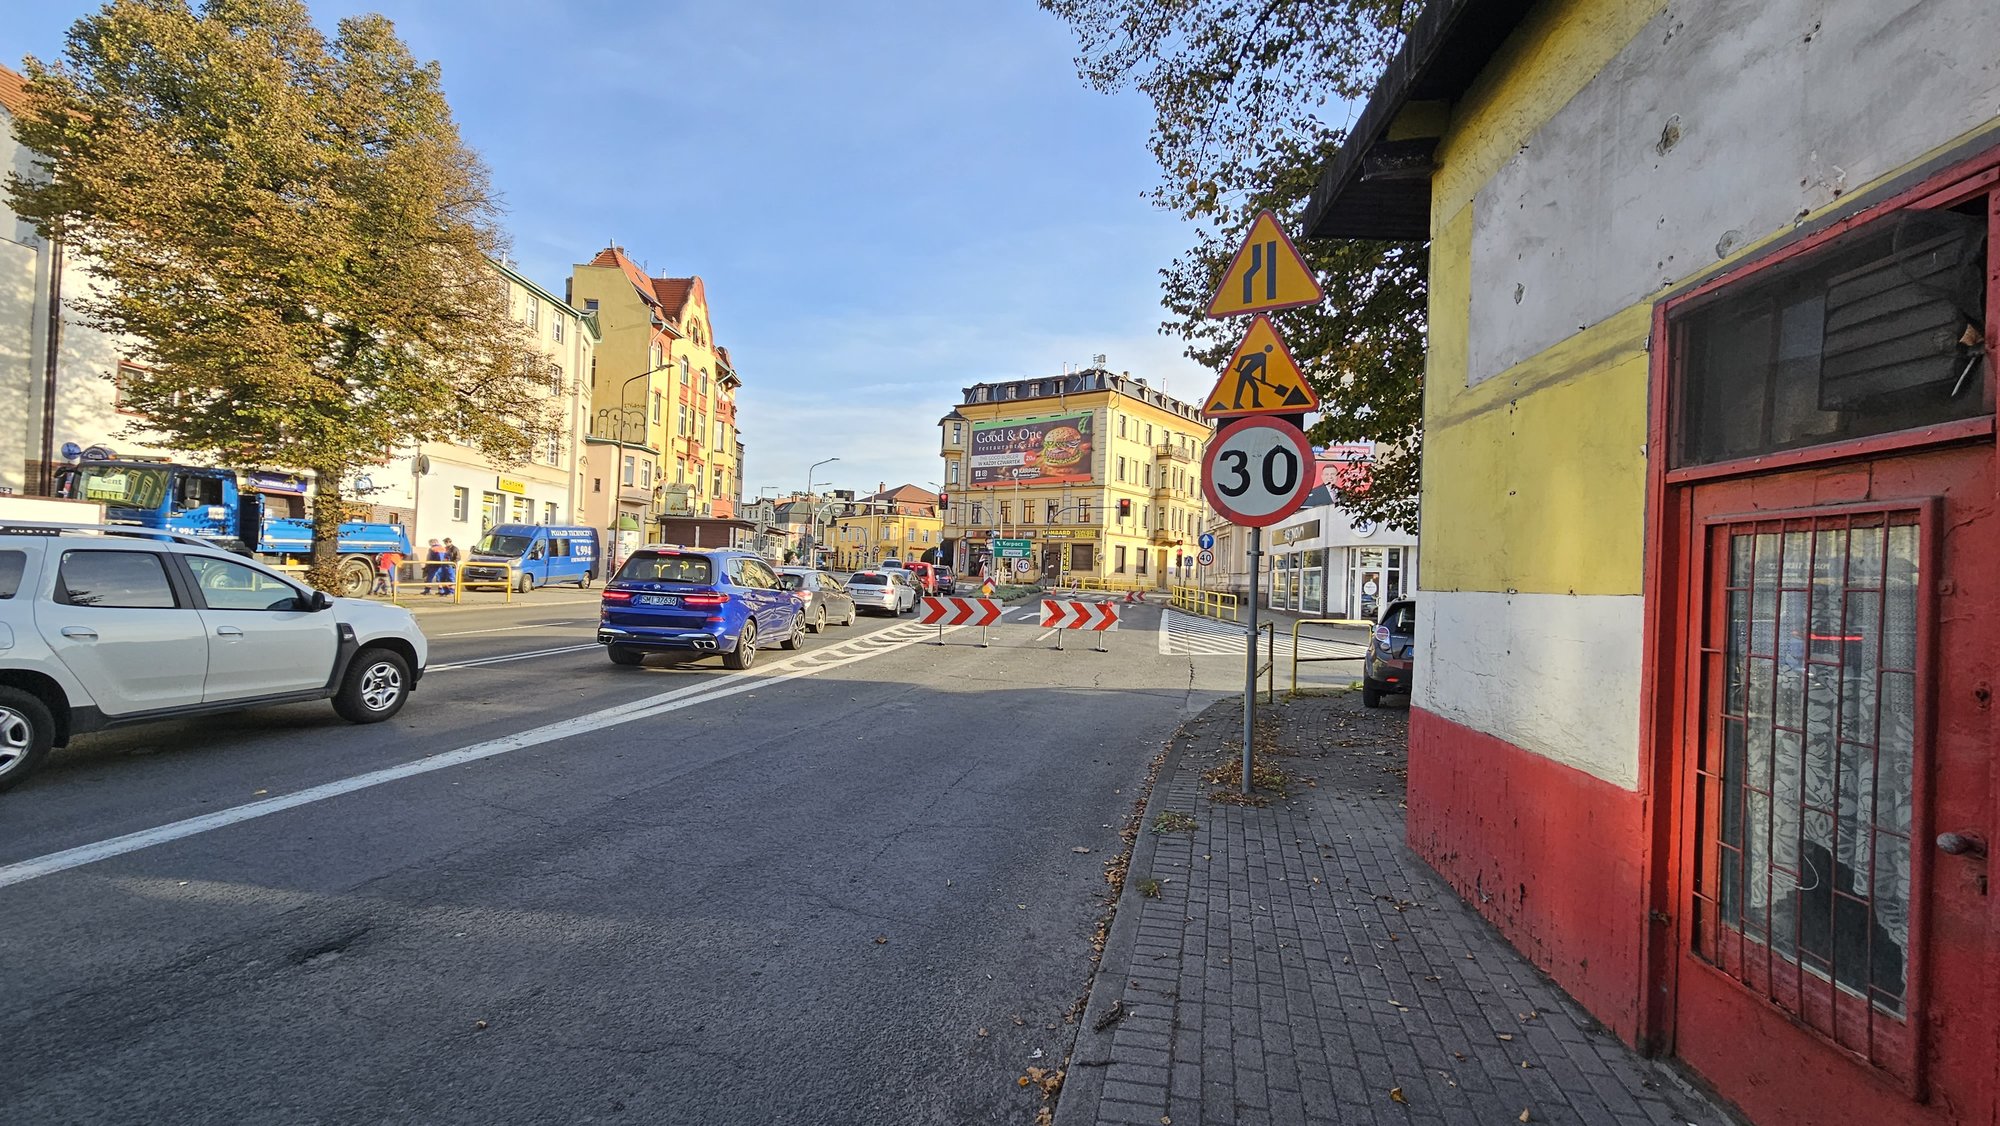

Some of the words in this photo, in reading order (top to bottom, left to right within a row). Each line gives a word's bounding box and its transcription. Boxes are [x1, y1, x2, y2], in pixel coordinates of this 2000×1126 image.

[976, 430, 1004, 443] Good
[1007, 429, 1014, 441] &
[1020, 428, 1043, 441] One
[1218, 445, 1298, 497] 30
[1018, 562, 1029, 570] 40
